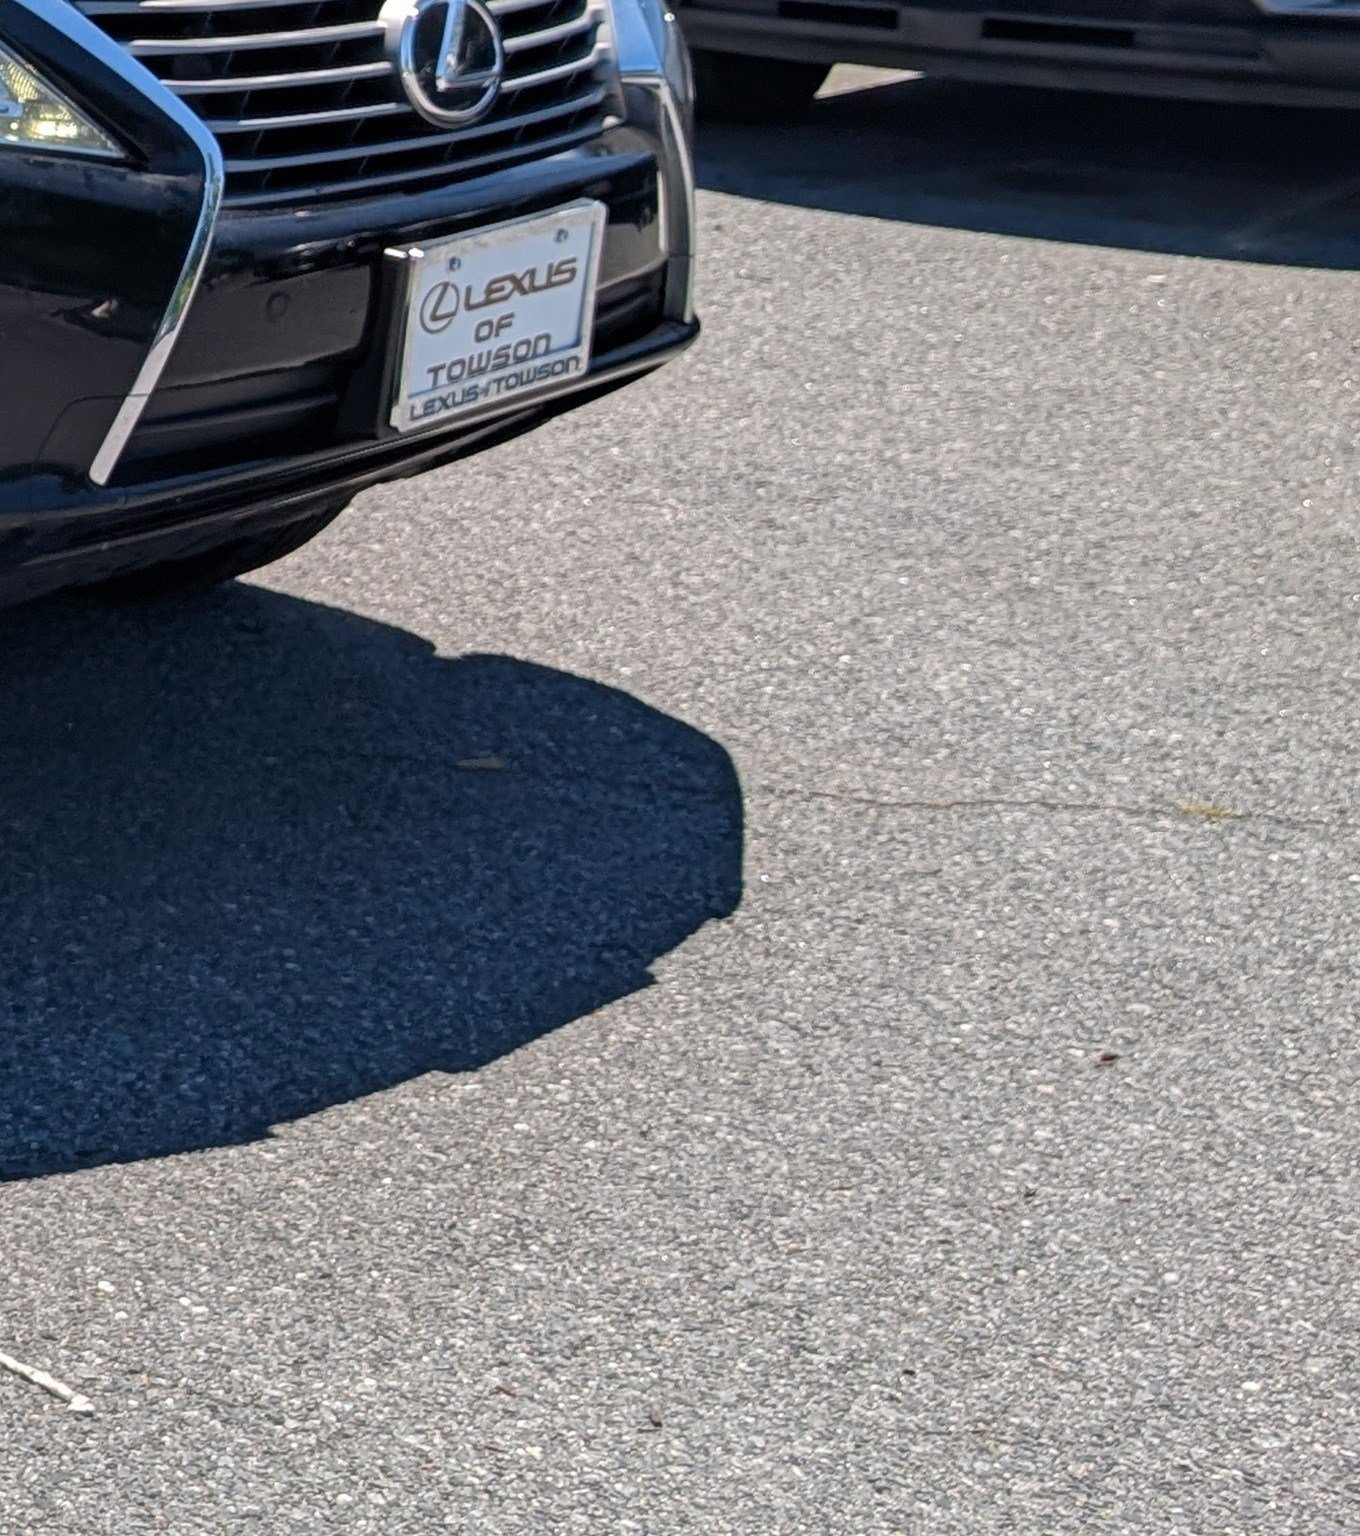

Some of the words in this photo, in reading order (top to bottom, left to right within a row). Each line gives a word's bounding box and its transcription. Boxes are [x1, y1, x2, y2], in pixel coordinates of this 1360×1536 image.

[464, 257, 578, 311] LEXUS
[474, 312, 515, 344] OF
[409, 382, 480, 422] LEXUS
[490, 354, 581, 395] TOWSON
[426, 332, 552, 390] TOWSON
